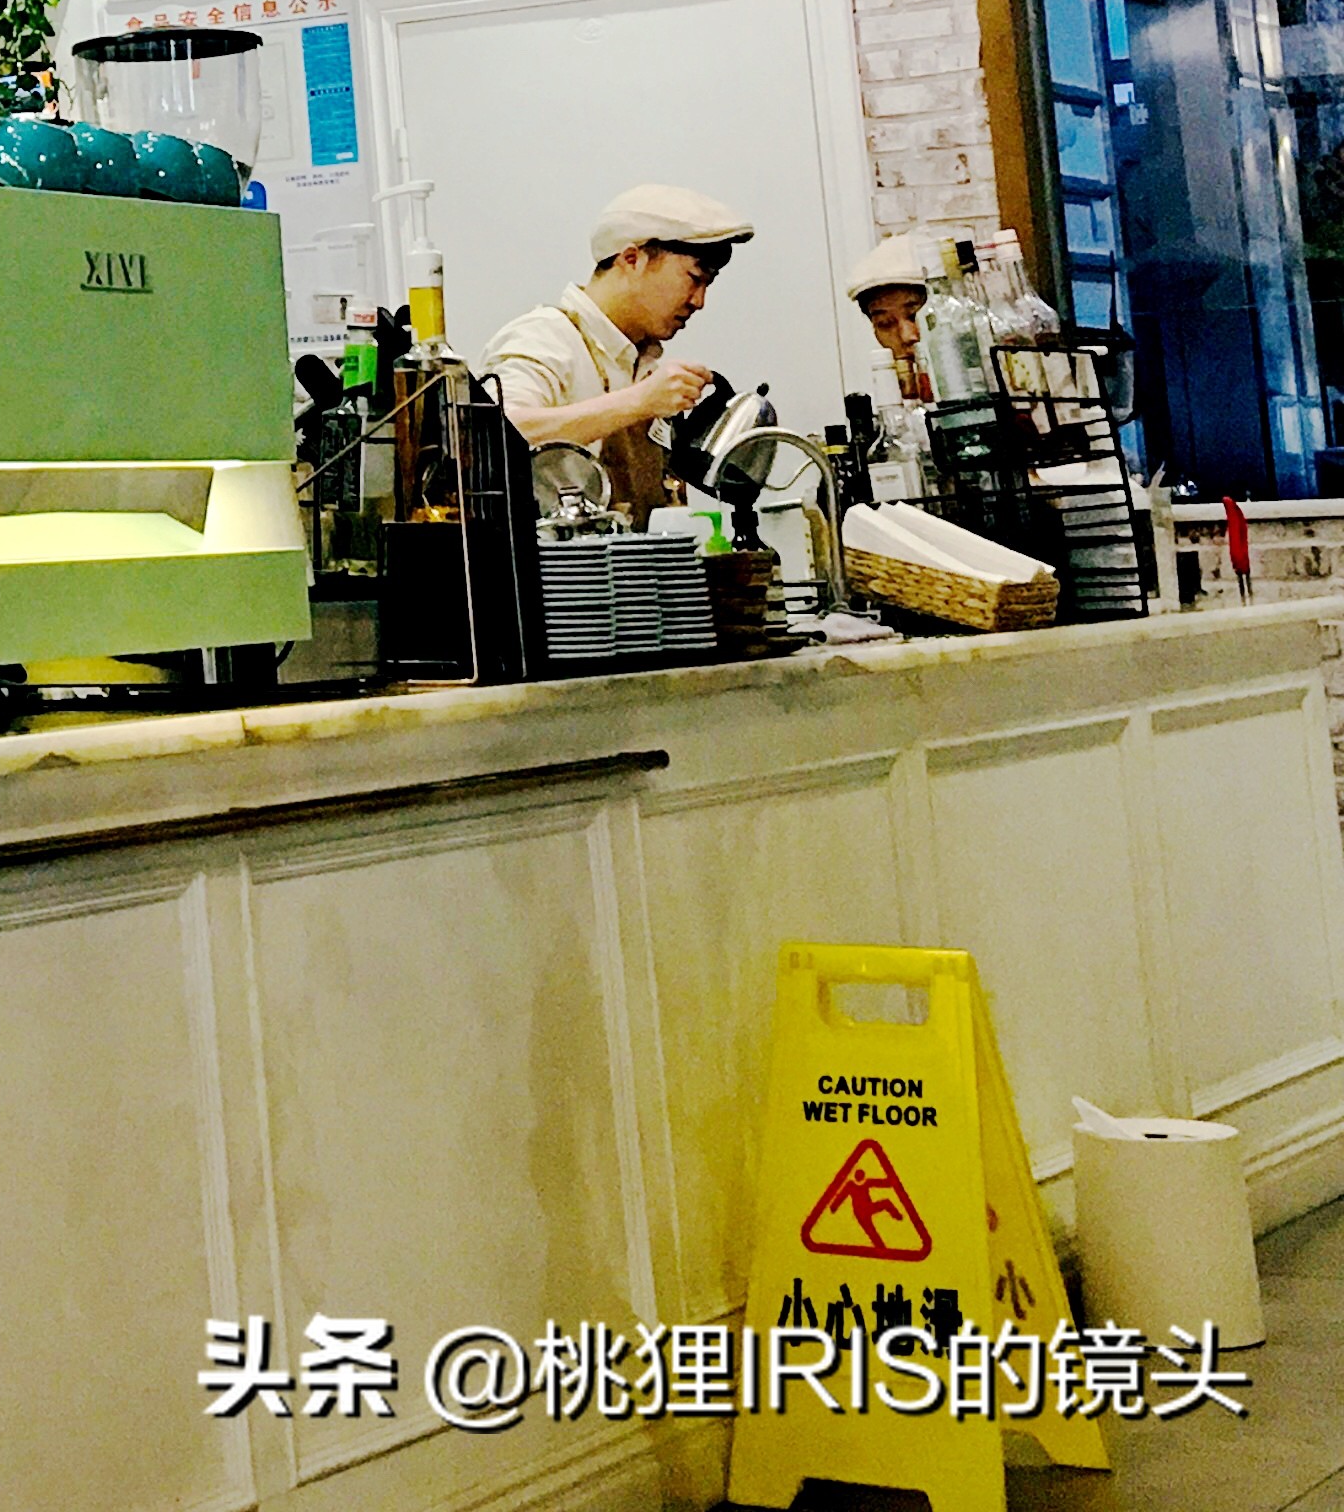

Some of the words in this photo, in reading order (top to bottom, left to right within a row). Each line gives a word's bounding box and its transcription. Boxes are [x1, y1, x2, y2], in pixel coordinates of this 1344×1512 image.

[817, 1074, 924, 1100] CAUTION
[802, 1101, 851, 1124] WET
[857, 1102, 938, 1128] FLOOR
